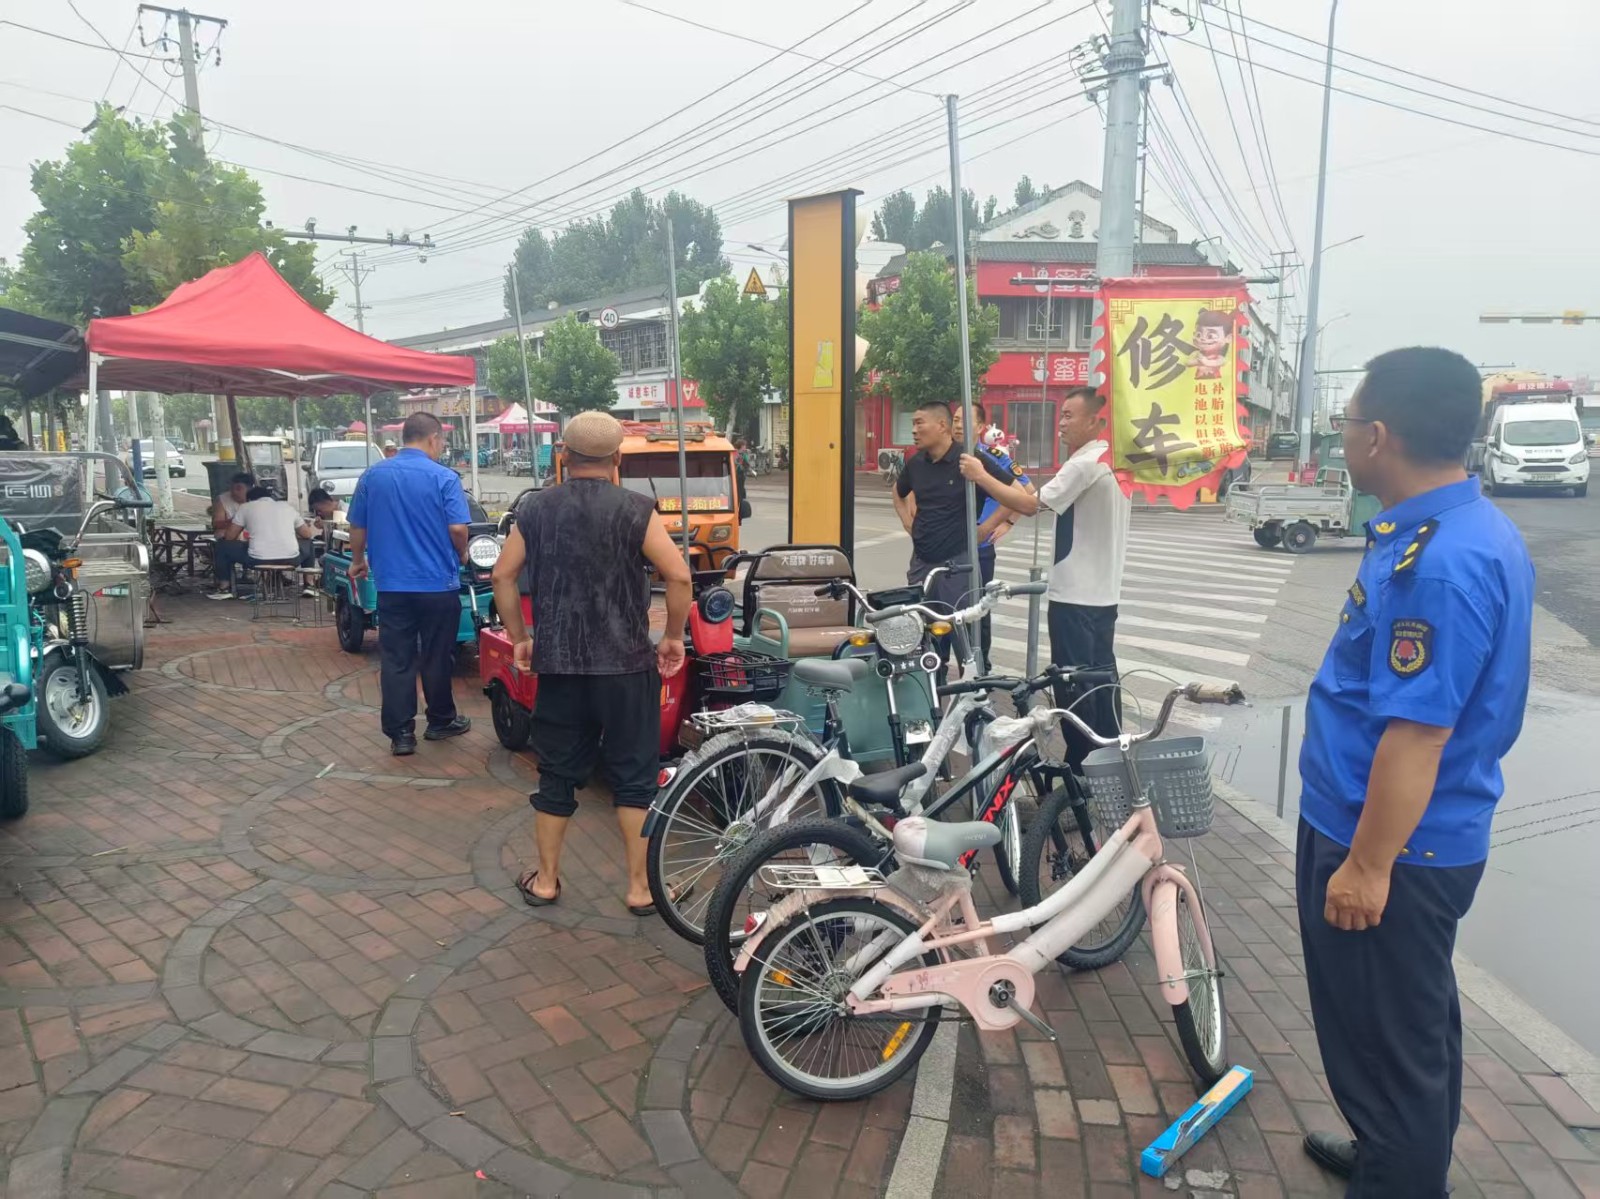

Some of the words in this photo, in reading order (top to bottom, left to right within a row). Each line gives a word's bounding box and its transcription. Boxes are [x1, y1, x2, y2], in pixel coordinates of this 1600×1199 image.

[603, 313, 615, 324] 40
[1117, 312, 1200, 477] 修车
[1212, 382, 1234, 456] 补胎更换胎
